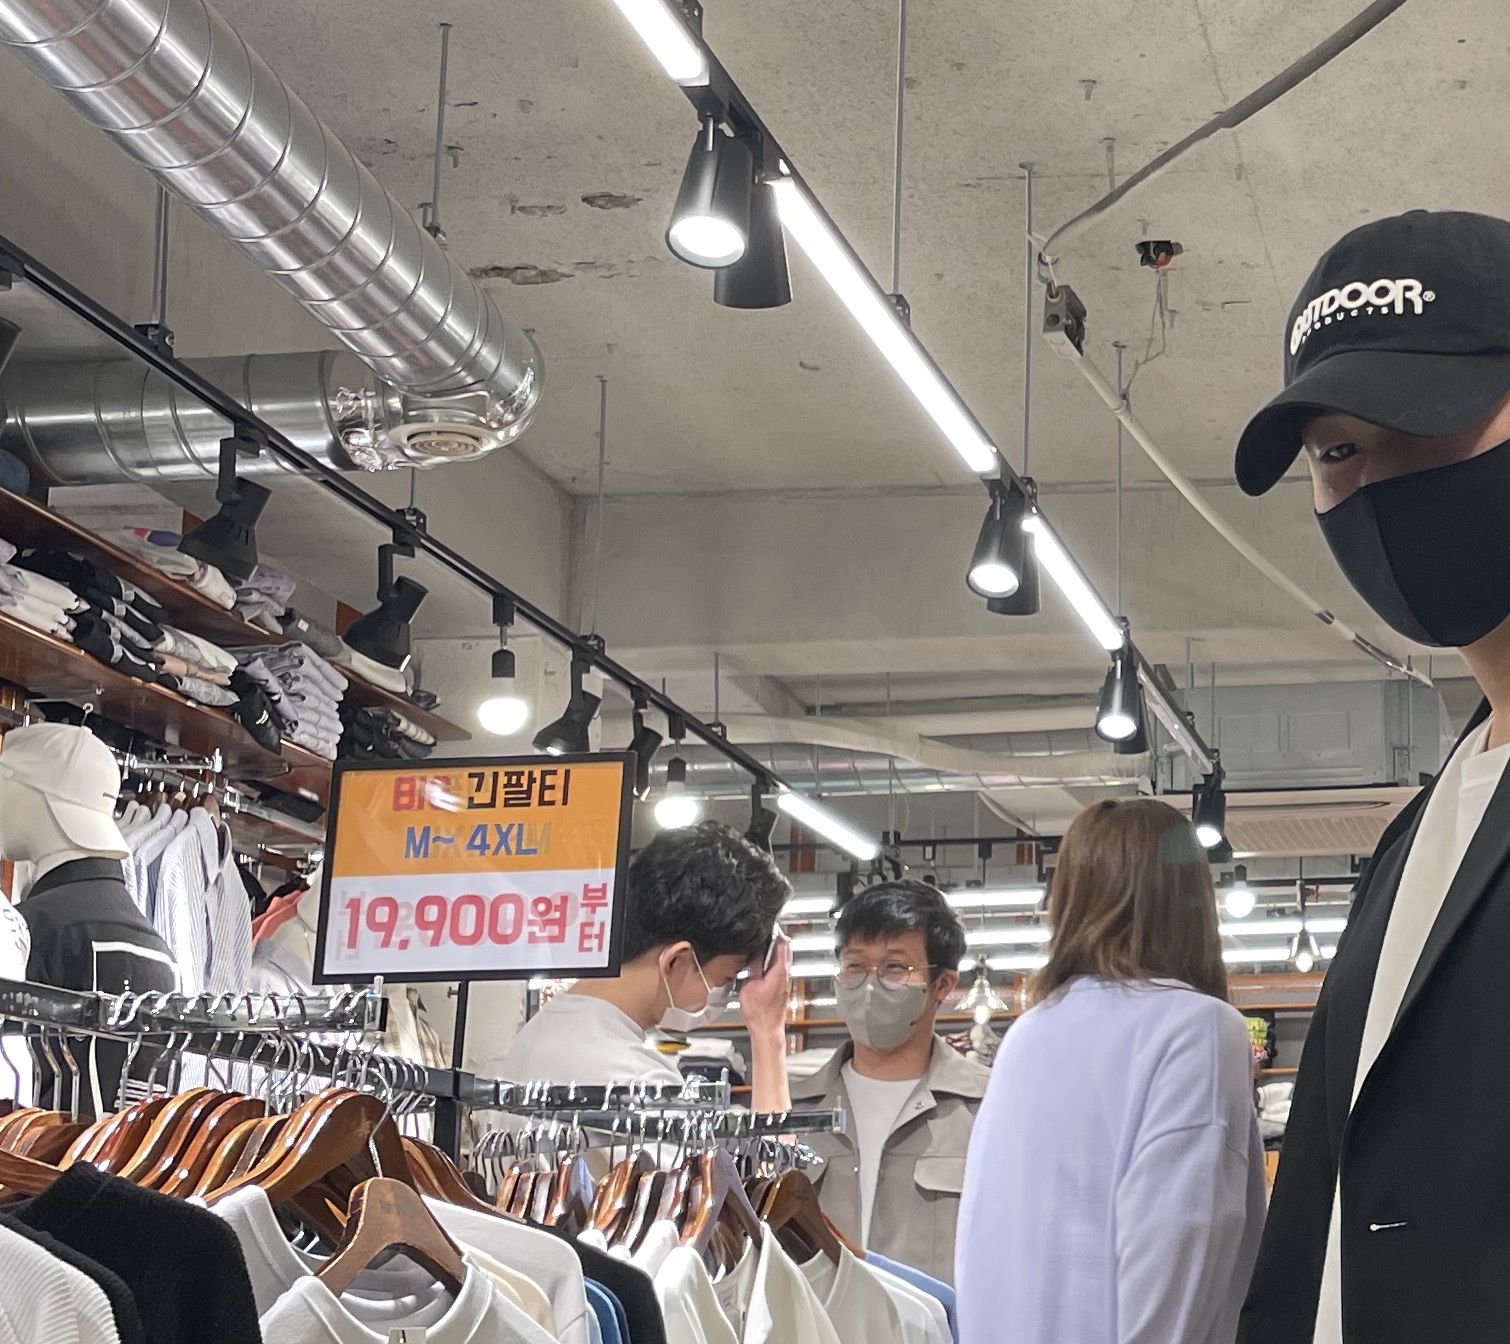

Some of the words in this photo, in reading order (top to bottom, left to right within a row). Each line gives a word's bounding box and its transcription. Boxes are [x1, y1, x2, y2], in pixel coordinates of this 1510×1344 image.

[1290, 278, 1424, 356] OUTDOOR
[466, 768, 571, 810] 긴팔티
[577, 882, 609, 953] 부터
